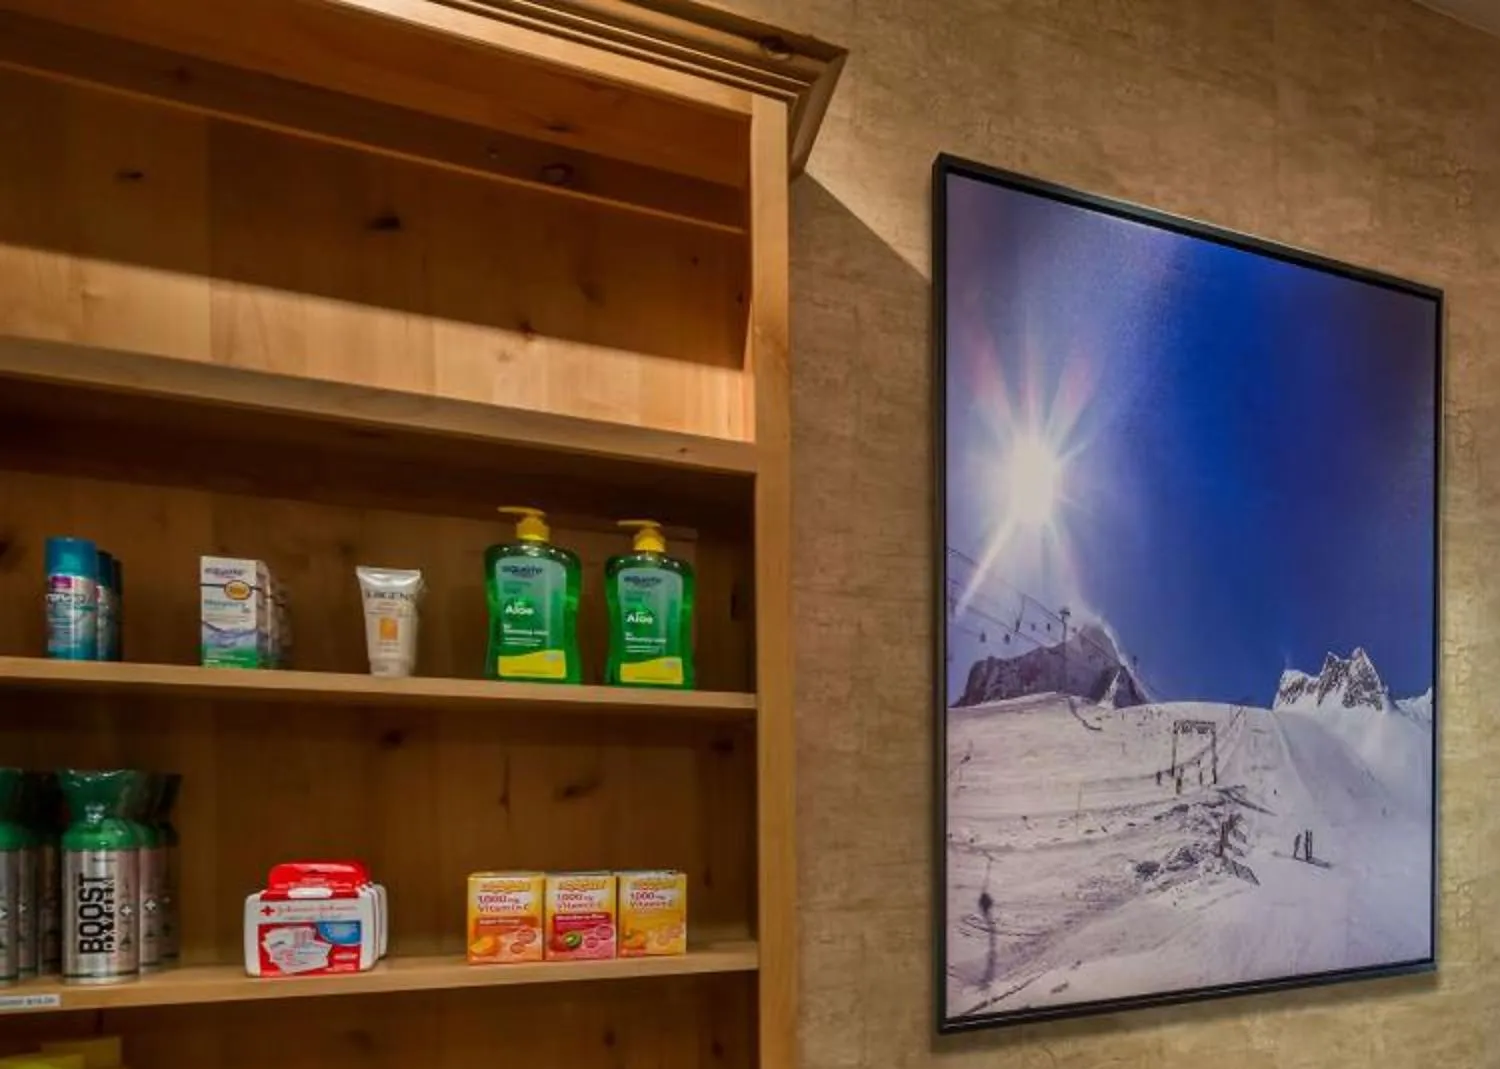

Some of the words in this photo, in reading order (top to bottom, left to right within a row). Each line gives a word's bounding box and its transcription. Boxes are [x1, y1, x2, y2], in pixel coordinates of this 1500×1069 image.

[505, 605, 534, 615] Aloe
[626, 614, 653, 624] Aloe
[79, 872, 104, 954] BOOST
